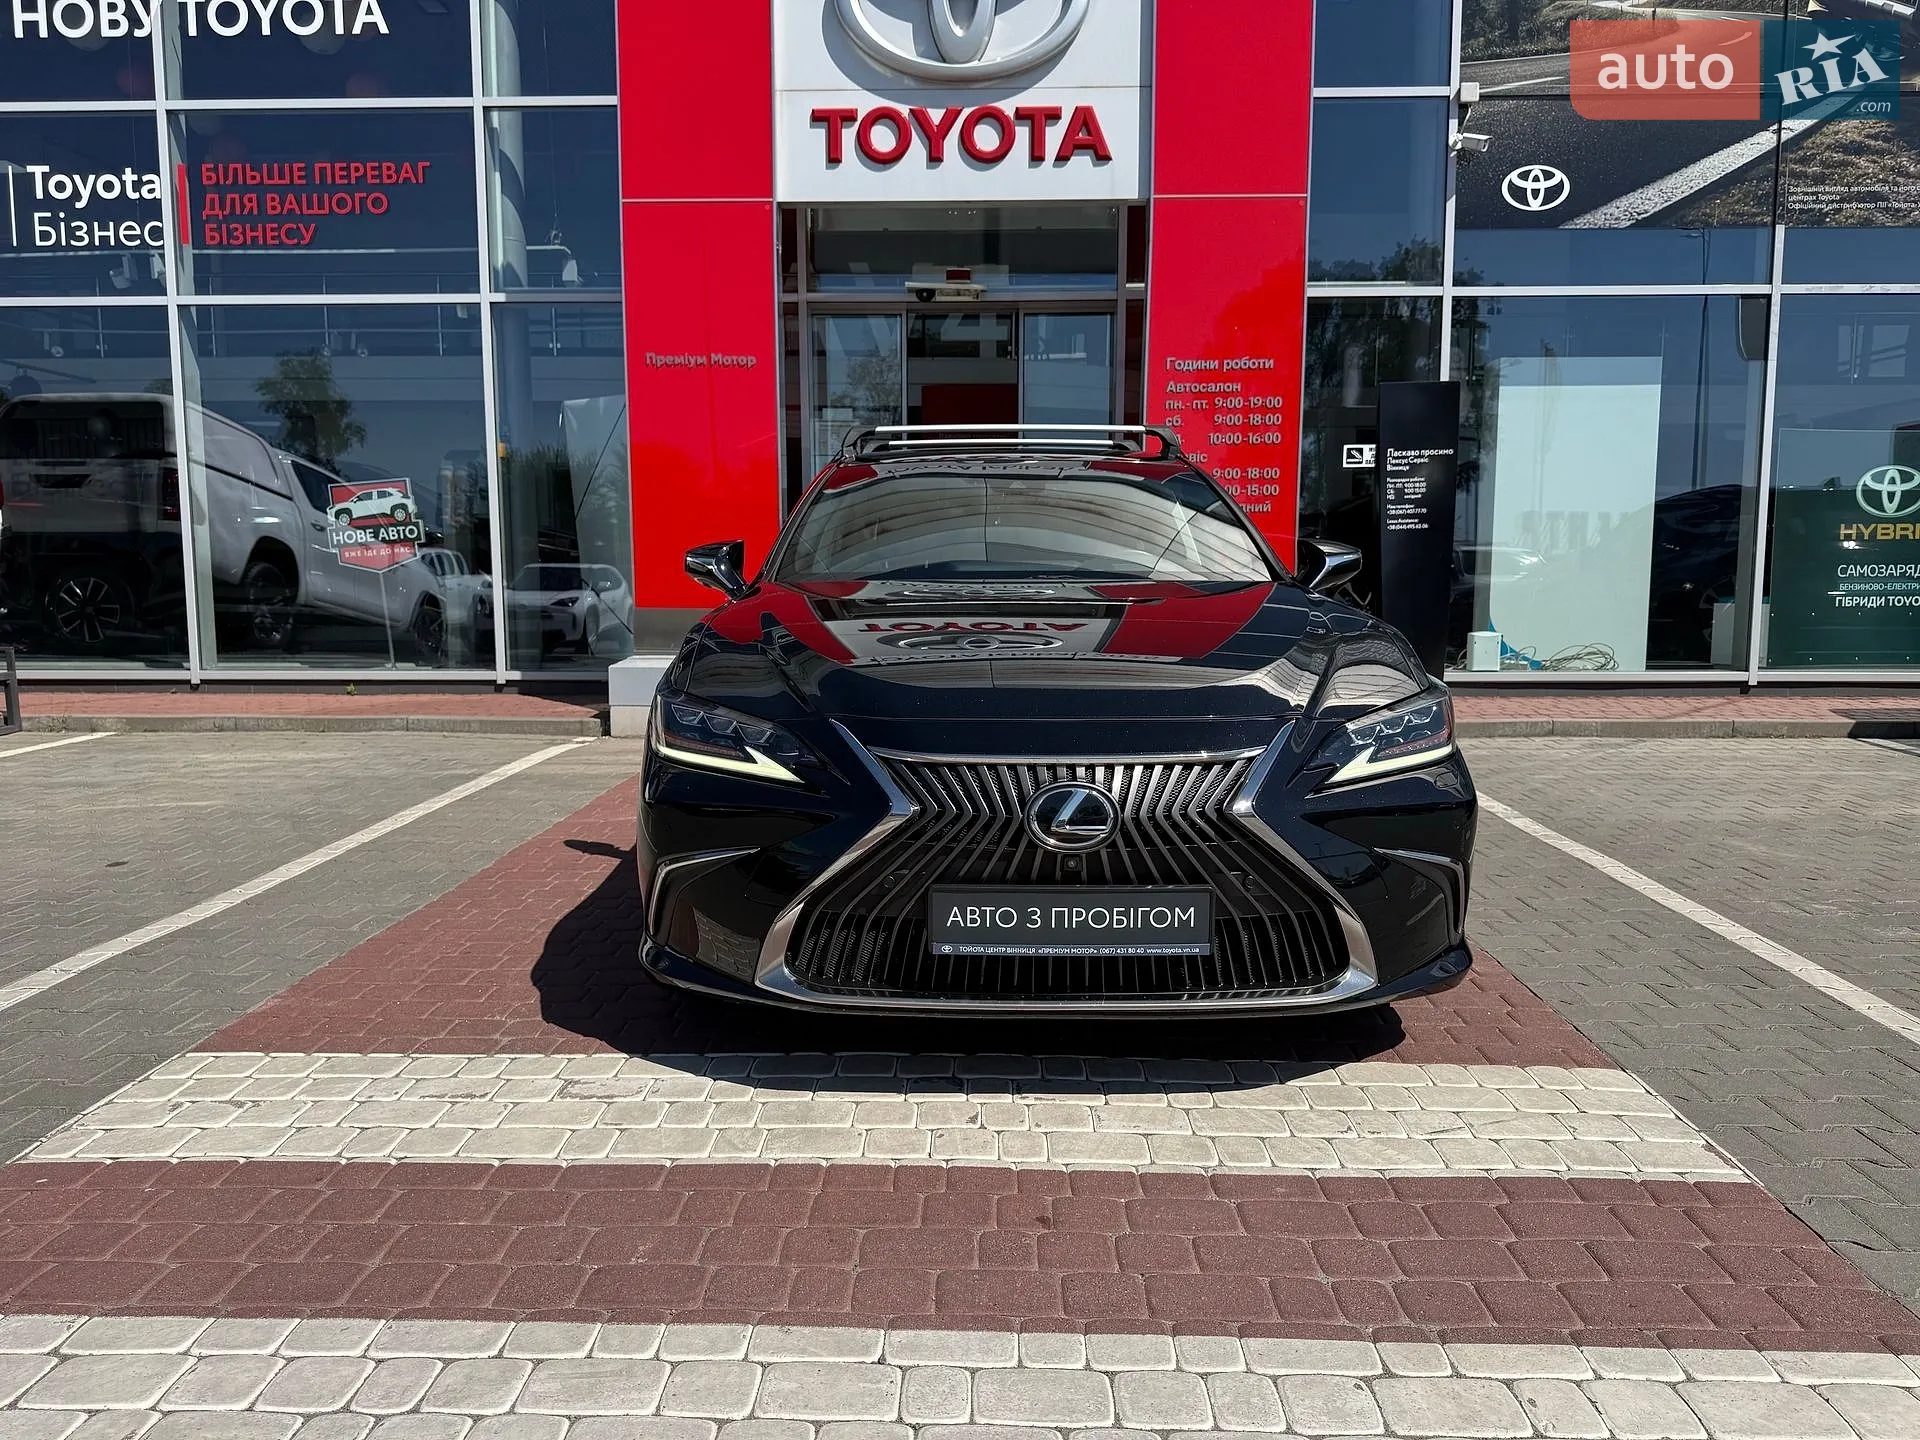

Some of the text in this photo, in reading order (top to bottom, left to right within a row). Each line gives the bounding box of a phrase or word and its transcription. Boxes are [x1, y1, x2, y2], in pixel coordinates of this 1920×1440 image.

[178, 0, 390, 37] TOYOTA
[811, 105, 1112, 164] TOYOTA
[201, 162, 430, 185] БІЛЬШЕ ПЕРЕВАГ
[26, 165, 161, 209] Toyota
[202, 192, 389, 220] ДЛЯ ВАШОГО
[34, 212, 164, 246] Бізнес
[205, 223, 316, 245] БІЗНЕСУ
[645, 352, 757, 367] Преміум Мотор
[1166, 356, 1274, 371] Години роботи
[1166, 381, 1241, 393] Автосалон
[333, 525, 418, 545] НОВЕ АВТО
[1836, 596, 1885, 608] ГІБРИДИ
[947, 906, 1017, 928] АВТО
[1051, 906, 1195, 929] ПРОБІГОМ
